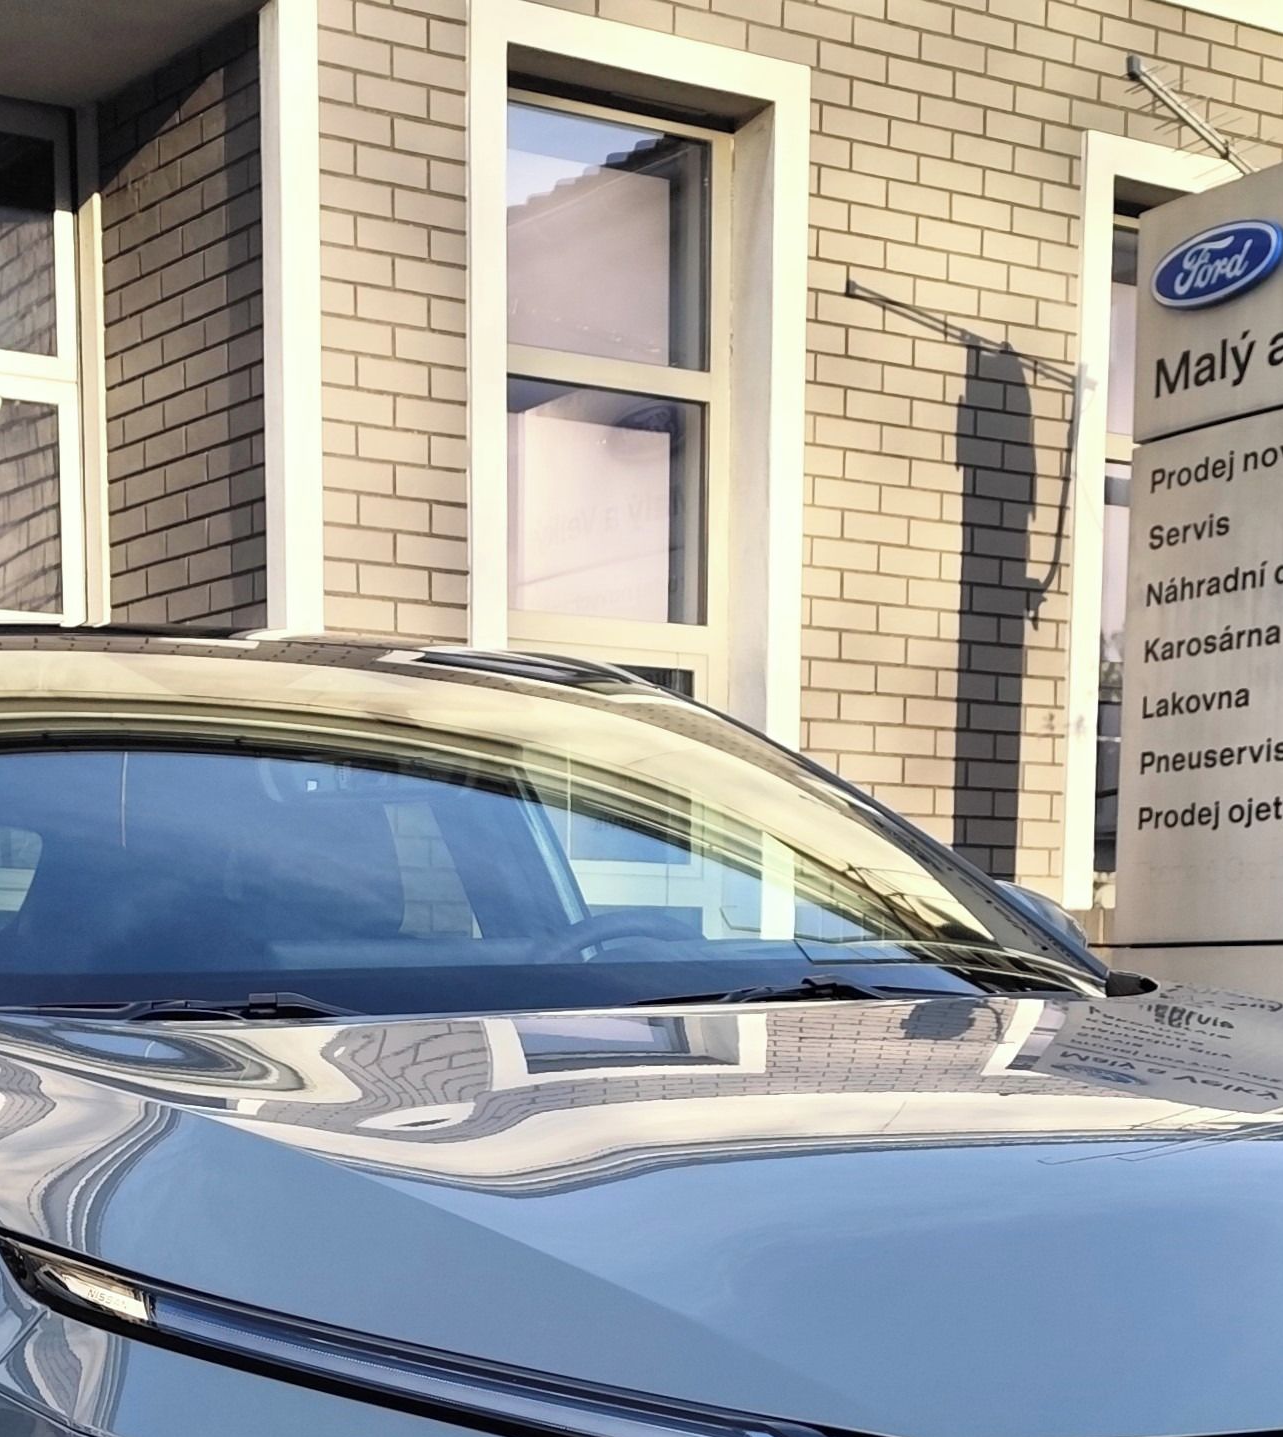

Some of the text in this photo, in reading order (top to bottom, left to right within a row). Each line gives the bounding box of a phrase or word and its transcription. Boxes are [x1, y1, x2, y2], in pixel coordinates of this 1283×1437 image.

[1174, 235, 1253, 295] Ford
[1154, 330, 1257, 398] Malý
[1150, 451, 1235, 494] Prodej
[1148, 514, 1230, 550] Servis
[1145, 561, 1268, 607] Náhradní
[1143, 624, 1281, 663] Karosárna
[1141, 687, 1250, 719] Lakovna
[1138, 801, 1220, 830] Prodej
